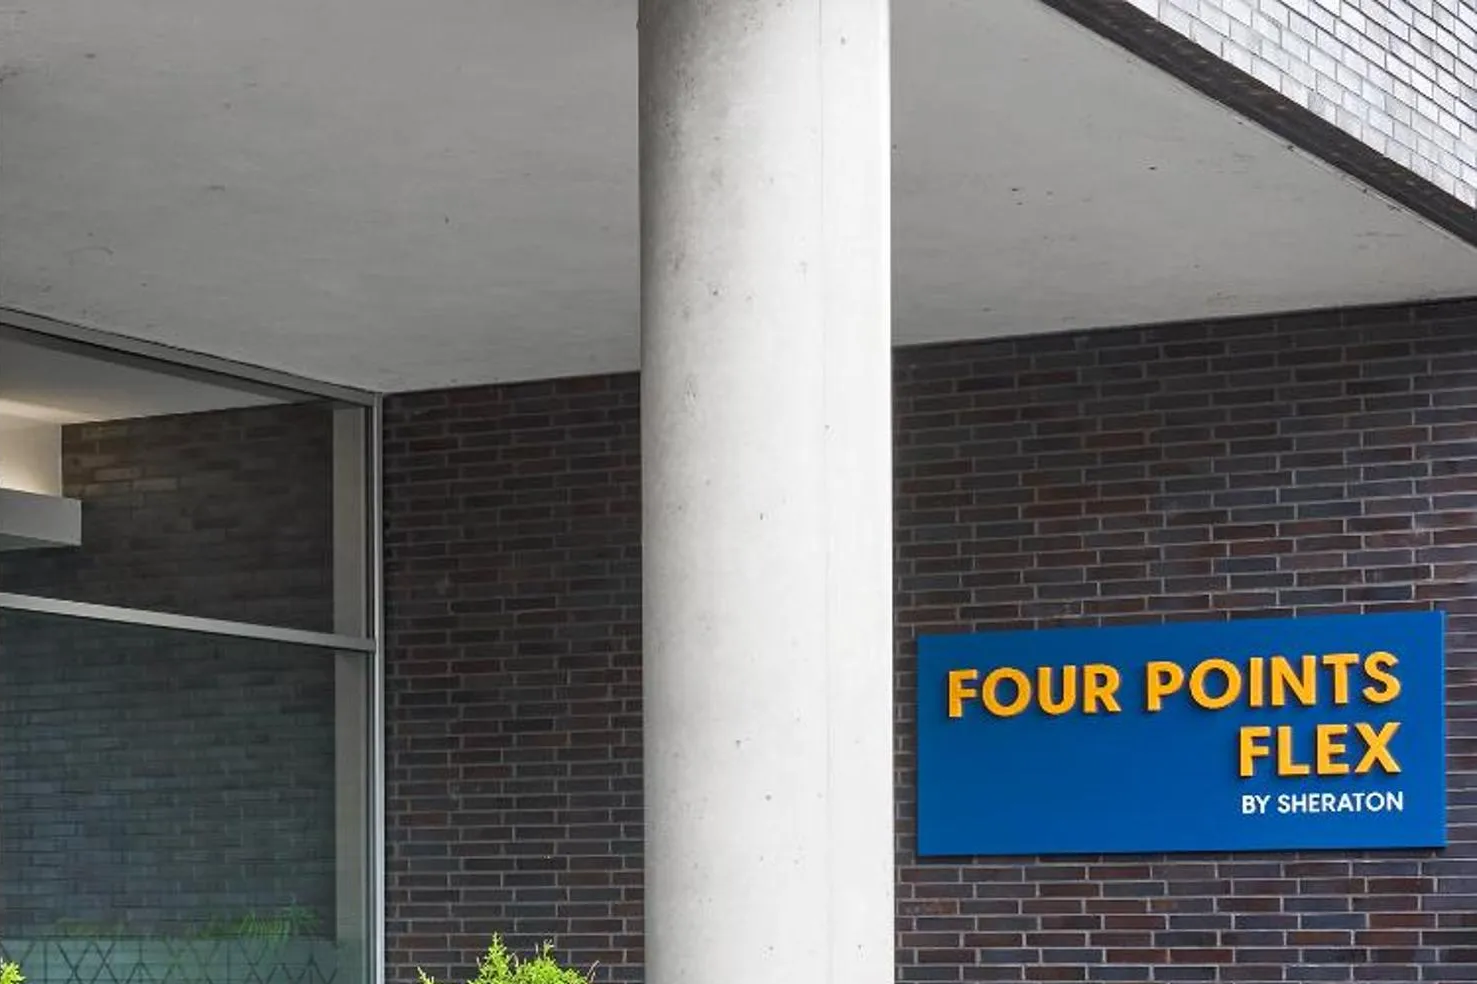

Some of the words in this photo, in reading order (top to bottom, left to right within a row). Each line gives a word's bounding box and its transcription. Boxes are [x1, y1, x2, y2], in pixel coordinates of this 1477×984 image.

[947, 662, 1121, 718] FOUR
[1145, 650, 1402, 712] POINTS
[1238, 721, 1402, 778] FLEX
[1241, 794, 1271, 815] BY
[1276, 791, 1404, 814] SHERATON
